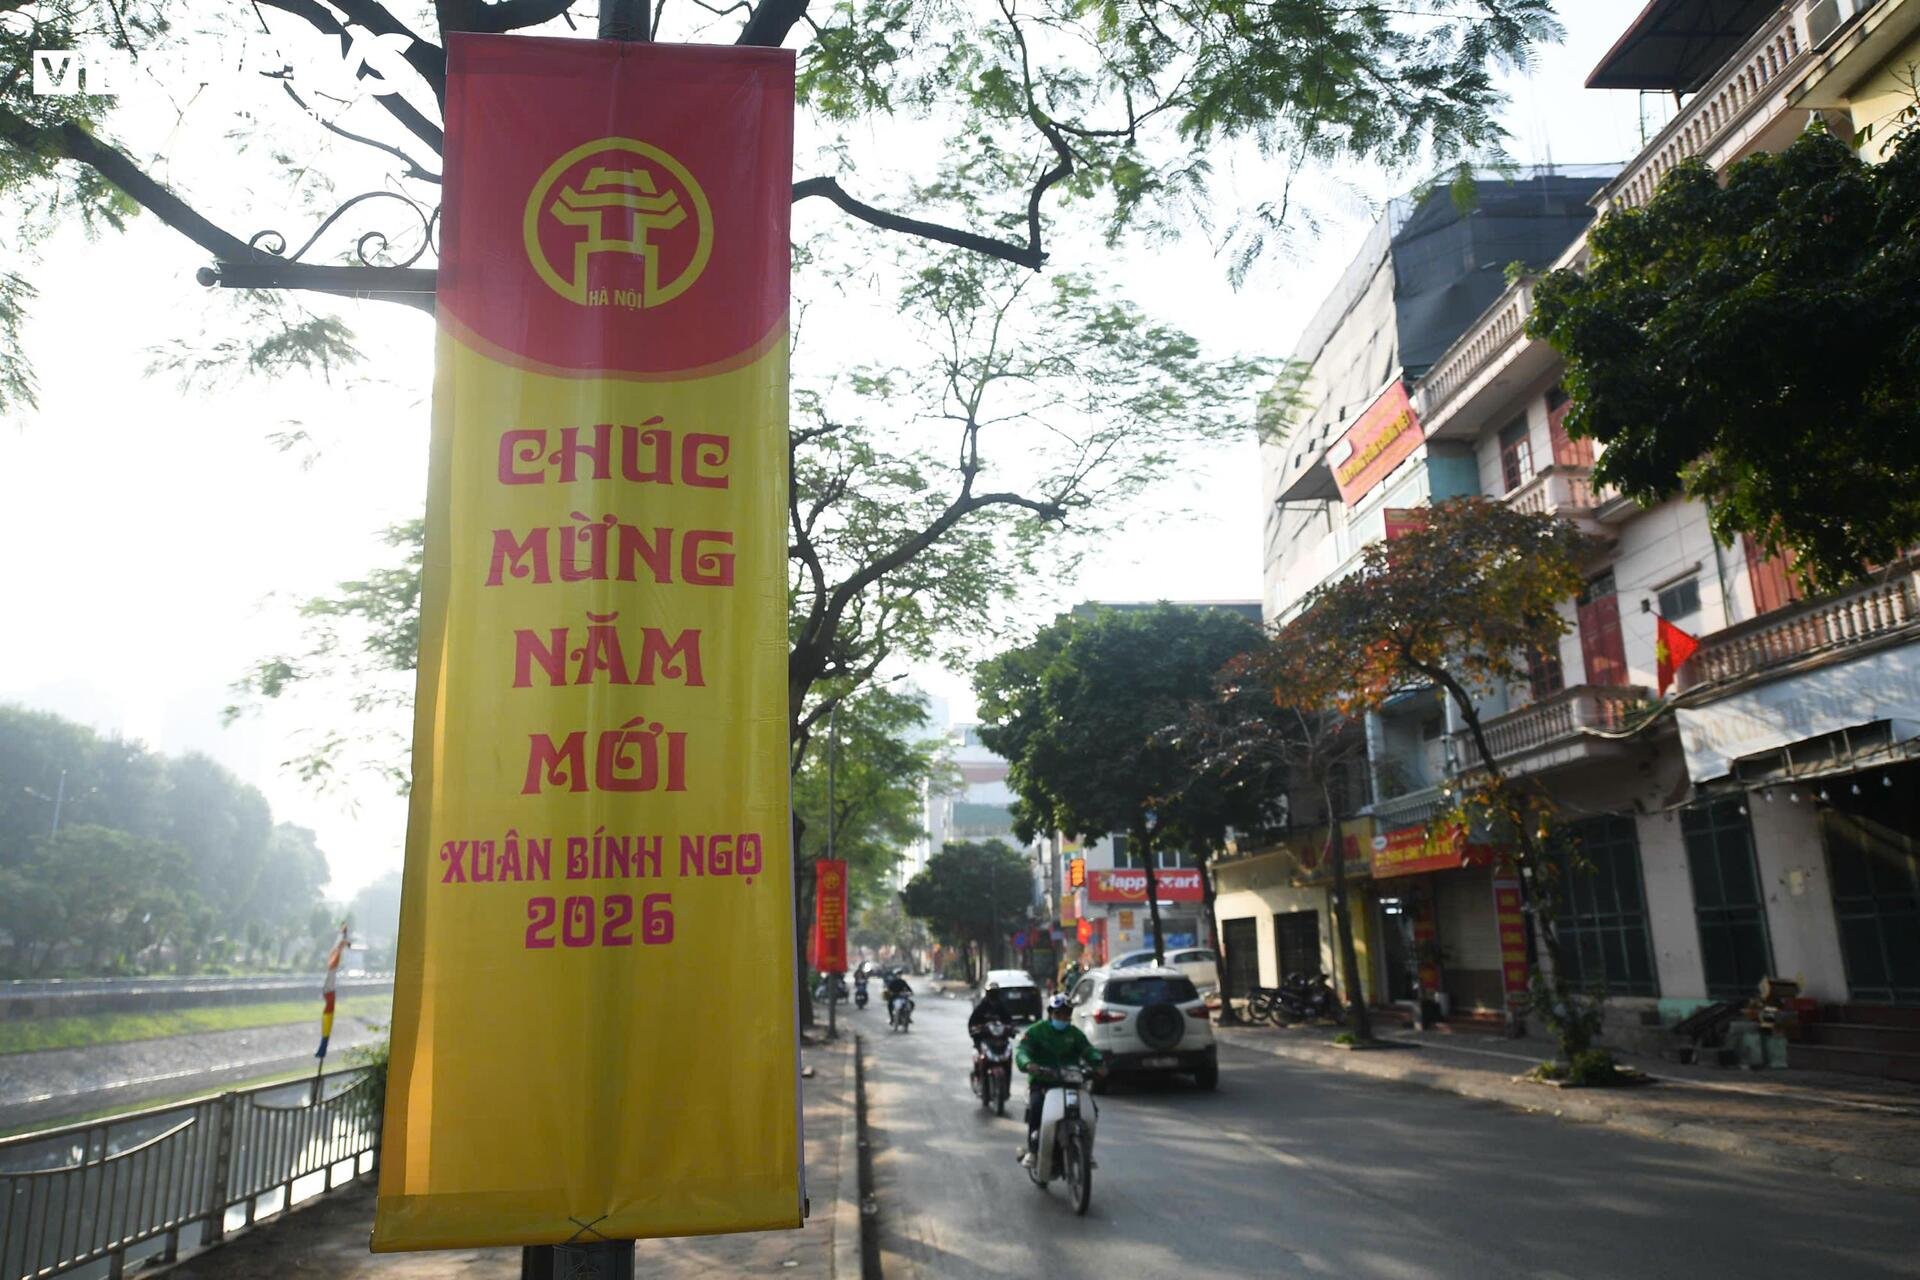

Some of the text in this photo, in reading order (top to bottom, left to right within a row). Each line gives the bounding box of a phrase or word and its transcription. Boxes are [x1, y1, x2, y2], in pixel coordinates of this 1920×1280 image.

[589, 286, 641, 311] HÀ NỘI
[498, 416, 730, 489] CHÚC
[485, 511, 736, 587] MỪNG
[512, 611, 706, 688] NĂM
[520, 716, 688, 795] MỚI
[440, 826, 762, 886] XUÂN BÍNH NGỌ
[1103, 873, 1150, 891] Happ
[525, 893, 674, 949] 2026
